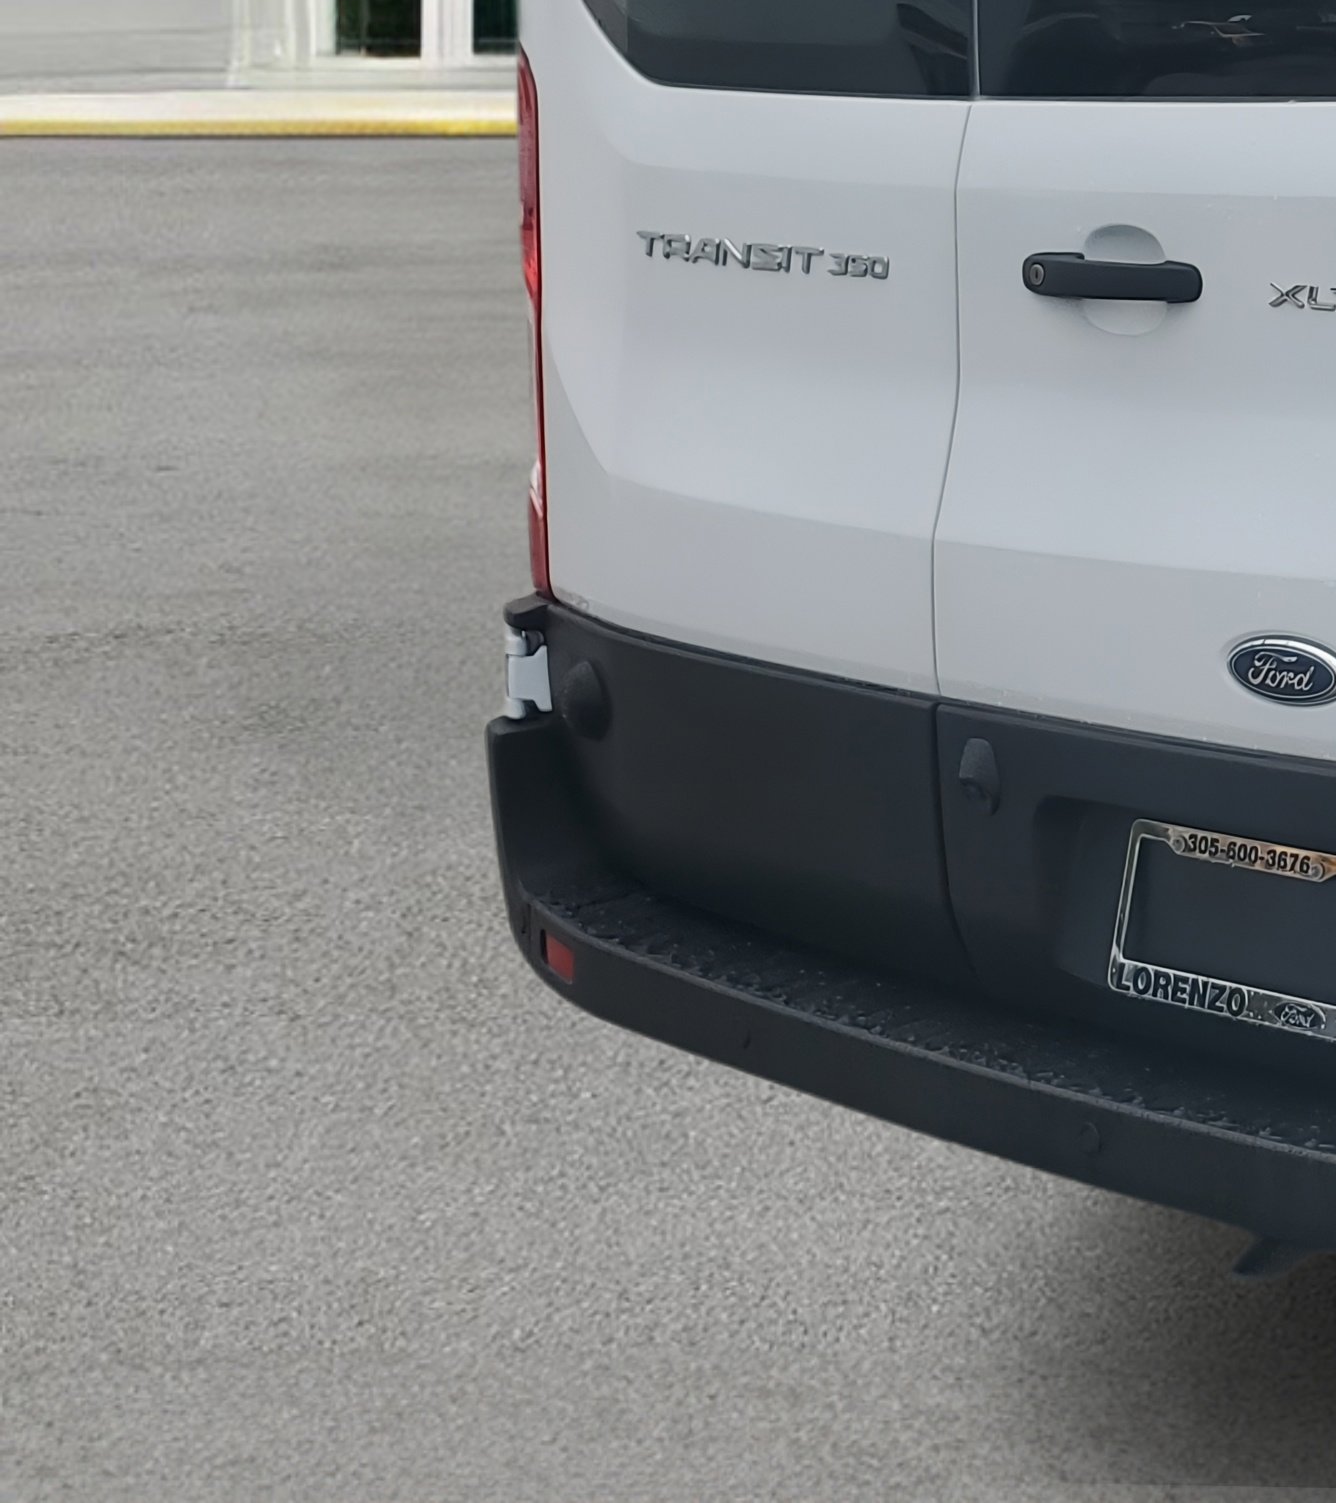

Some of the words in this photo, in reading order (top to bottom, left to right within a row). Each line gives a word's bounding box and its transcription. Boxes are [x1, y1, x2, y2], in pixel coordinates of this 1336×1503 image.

[636, 230, 825, 275] TRANSIT
[827, 253, 890, 279] 350
[1247, 650, 1316, 692] Ford
[1187, 832, 1311, 875] 305-600-3676
[1115, 961, 1248, 1018] LORENZO
